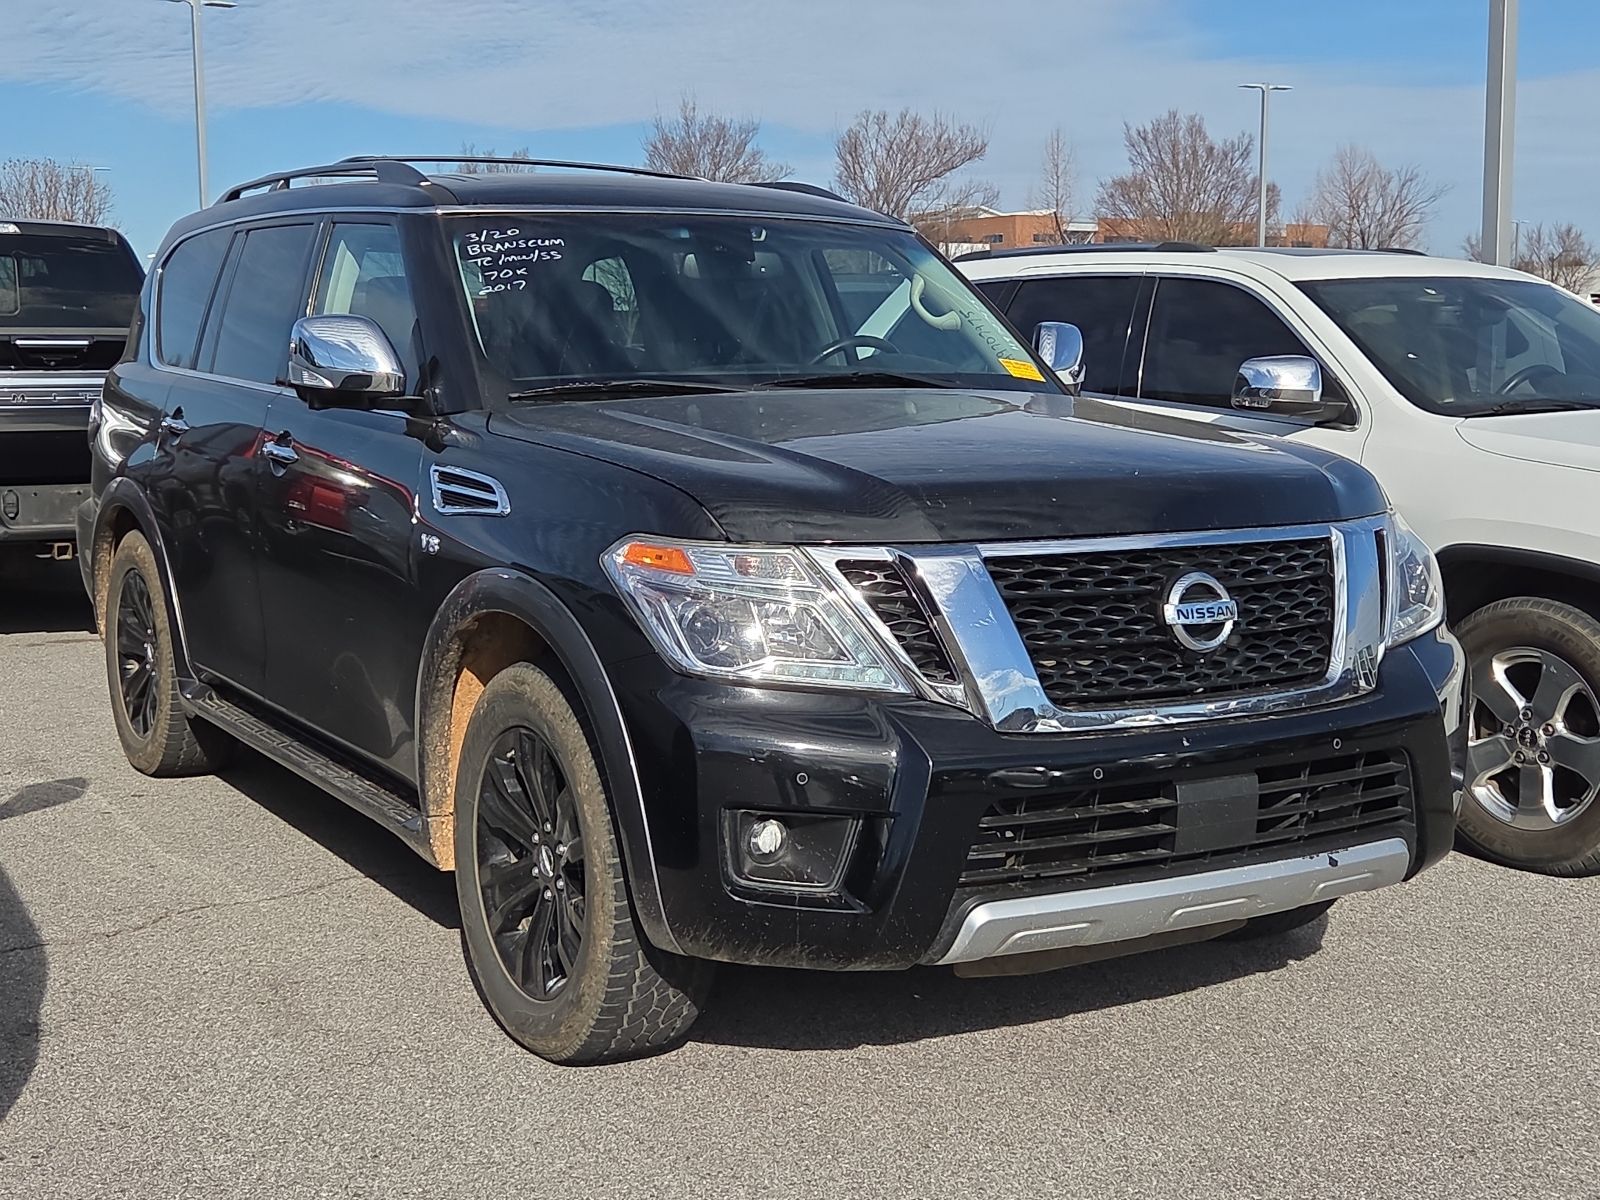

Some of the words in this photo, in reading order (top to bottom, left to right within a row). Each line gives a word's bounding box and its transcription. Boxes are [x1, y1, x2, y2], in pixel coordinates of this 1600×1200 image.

[465, 228, 520, 242] 3/20
[466, 238, 565, 256] BRANSCUM
[478, 280, 526, 296] 2017
[1176, 605, 1234, 621] NISSAN
